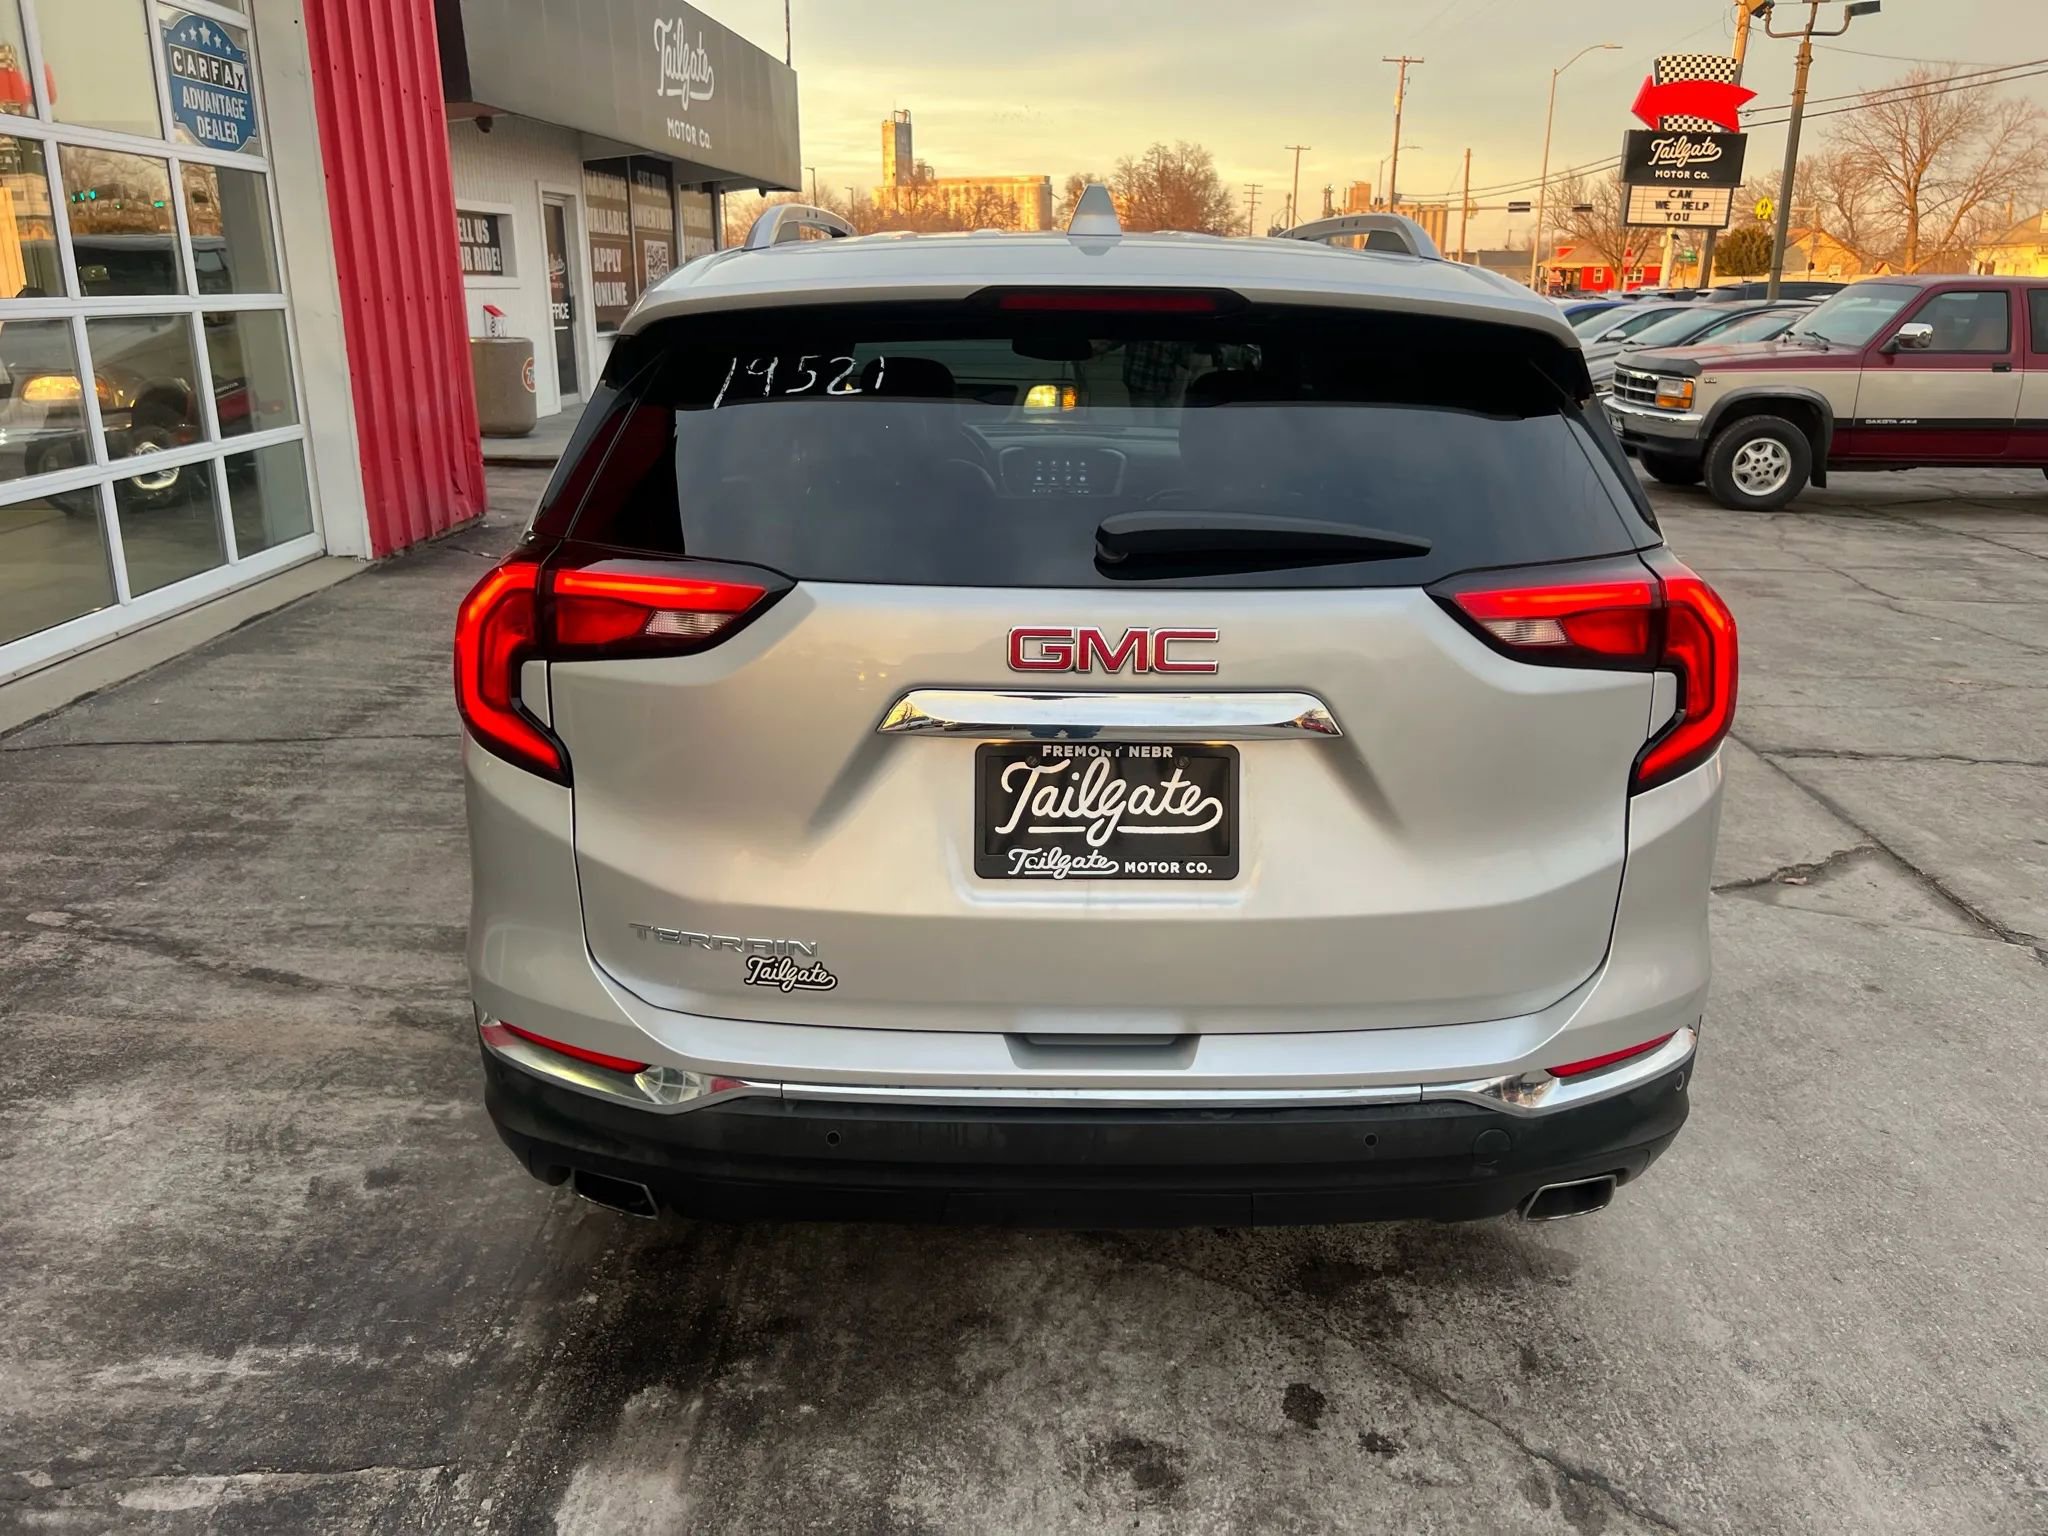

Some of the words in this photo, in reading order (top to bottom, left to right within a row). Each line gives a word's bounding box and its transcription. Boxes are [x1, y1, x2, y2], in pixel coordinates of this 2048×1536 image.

[171, 49, 248, 94] CARFAX
[654, 17, 715, 111] Tailgate
[182, 85, 247, 120] ADVANTAGE
[196, 115, 240, 145] DEALER
[667, 116, 697, 144] MOTOR
[699, 130, 713, 150] CO.
[1648, 135, 1722, 167] Tailgate
[1655, 169, 1690, 180] MOTOR
[1694, 170, 1710, 180] CO.
[1655, 200, 1671, 210] WE
[1681, 200, 1710, 210] HELP
[1668, 189, 1693, 199] CAN
[474, 219, 490, 244] US
[1666, 212, 1690, 222] YOU
[473, 247, 502, 272] RIDE!
[593, 247, 621, 272] APPLY
[594, 281, 628, 307] ONLINE
[712, 354, 886, 409] 19521
[1007, 625, 1219, 674] GMC
[1042, 745, 1122, 758] FREMONT
[1128, 745, 1174, 758] NEBR
[994, 756, 1223, 848] Tailgate
[1007, 847, 1120, 880] Tailgate
[1124, 861, 1180, 874] MOTOR
[1186, 861, 1213, 874] CO.
[628, 922, 818, 958] TERRAIN
[744, 955, 838, 993] Tailgate
